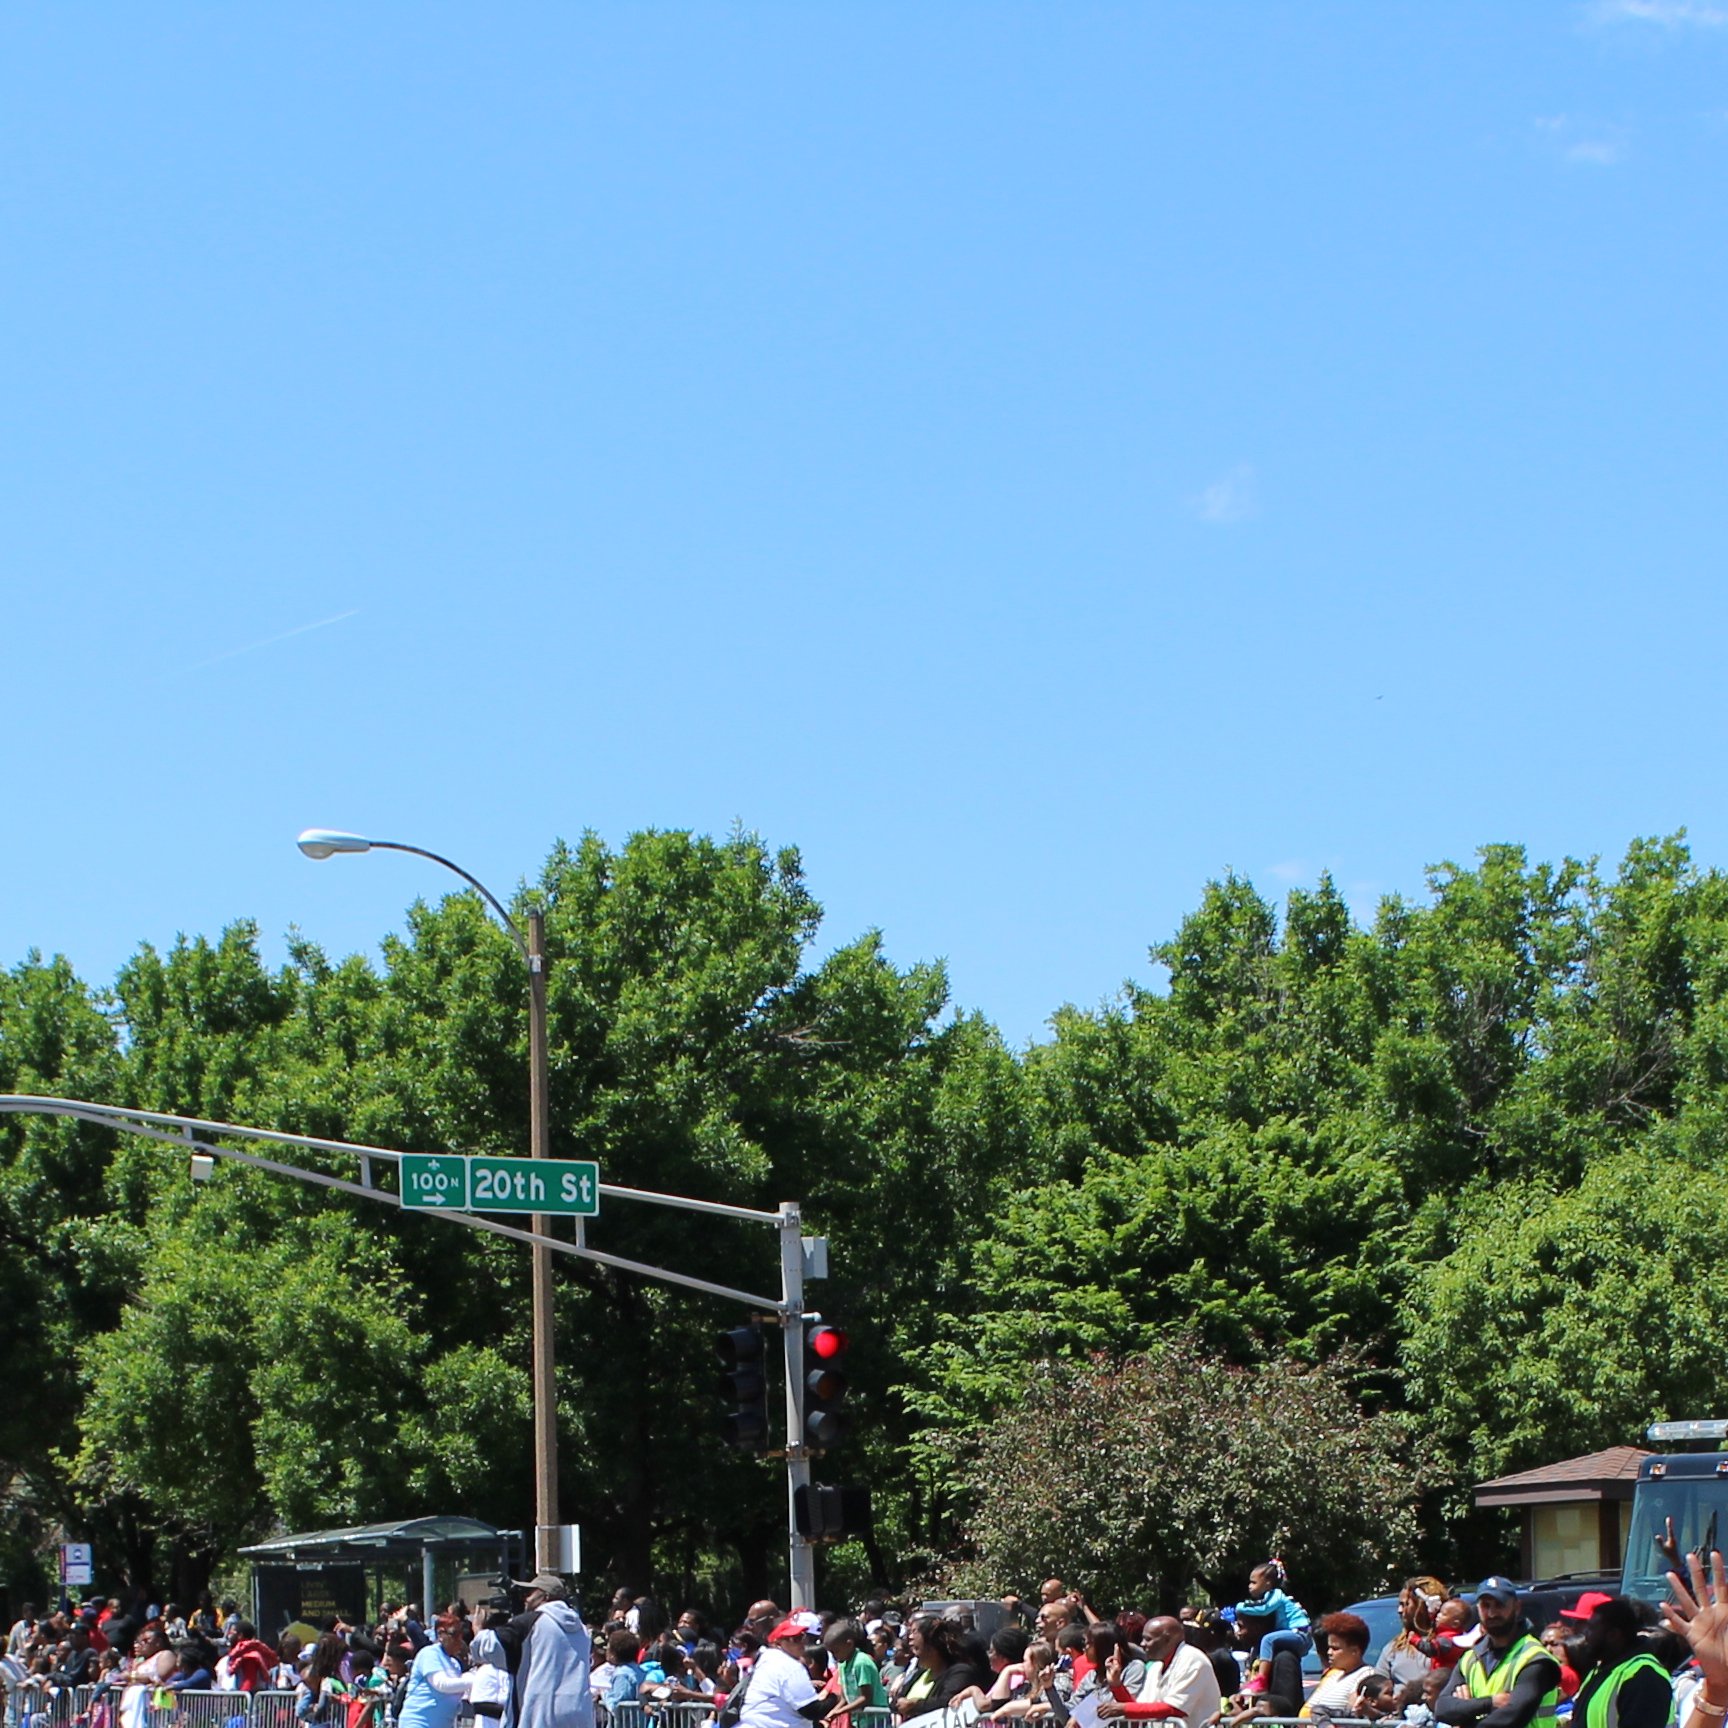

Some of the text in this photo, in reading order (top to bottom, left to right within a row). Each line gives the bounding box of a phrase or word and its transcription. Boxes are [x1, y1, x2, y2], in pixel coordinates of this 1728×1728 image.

[474, 1168, 592, 1204] 20th St
[301, 1600, 336, 1608] MEDIUM
